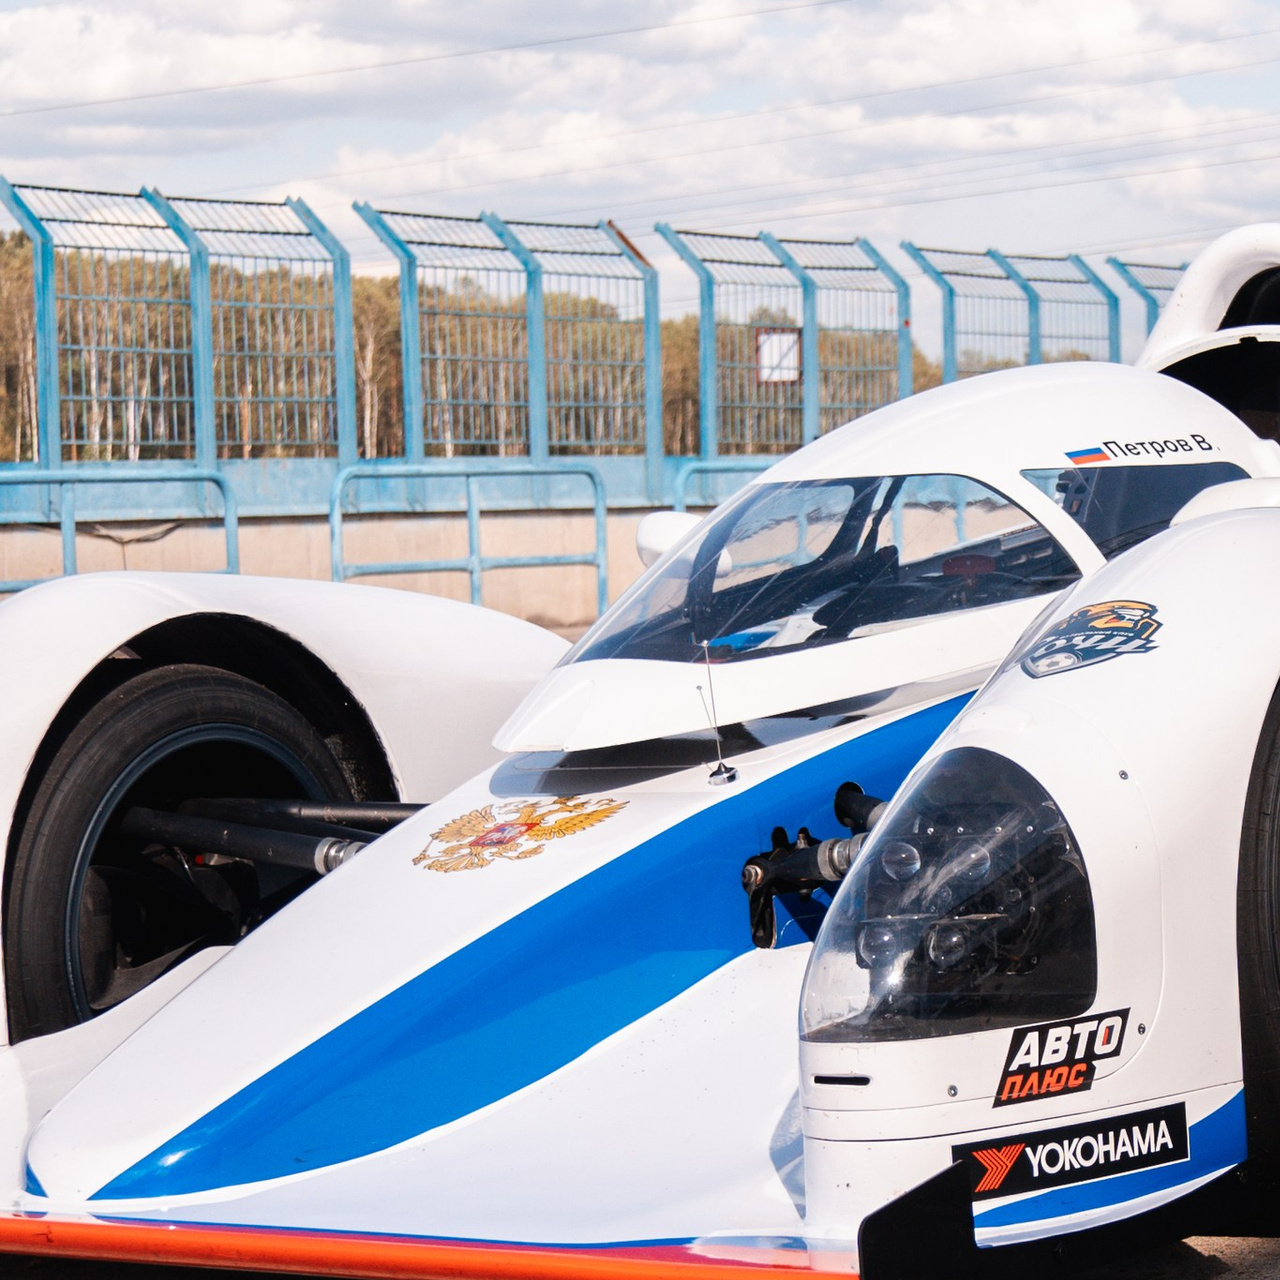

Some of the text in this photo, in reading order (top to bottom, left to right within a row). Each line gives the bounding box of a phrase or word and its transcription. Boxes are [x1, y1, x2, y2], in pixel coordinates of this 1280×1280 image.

[1102, 438, 1194, 459] Петров
[1008, 1016, 1122, 1071] АВТО
[1001, 1063, 1087, 1101] ПЛЮС
[1025, 1120, 1174, 1177] YOKOHAMA
